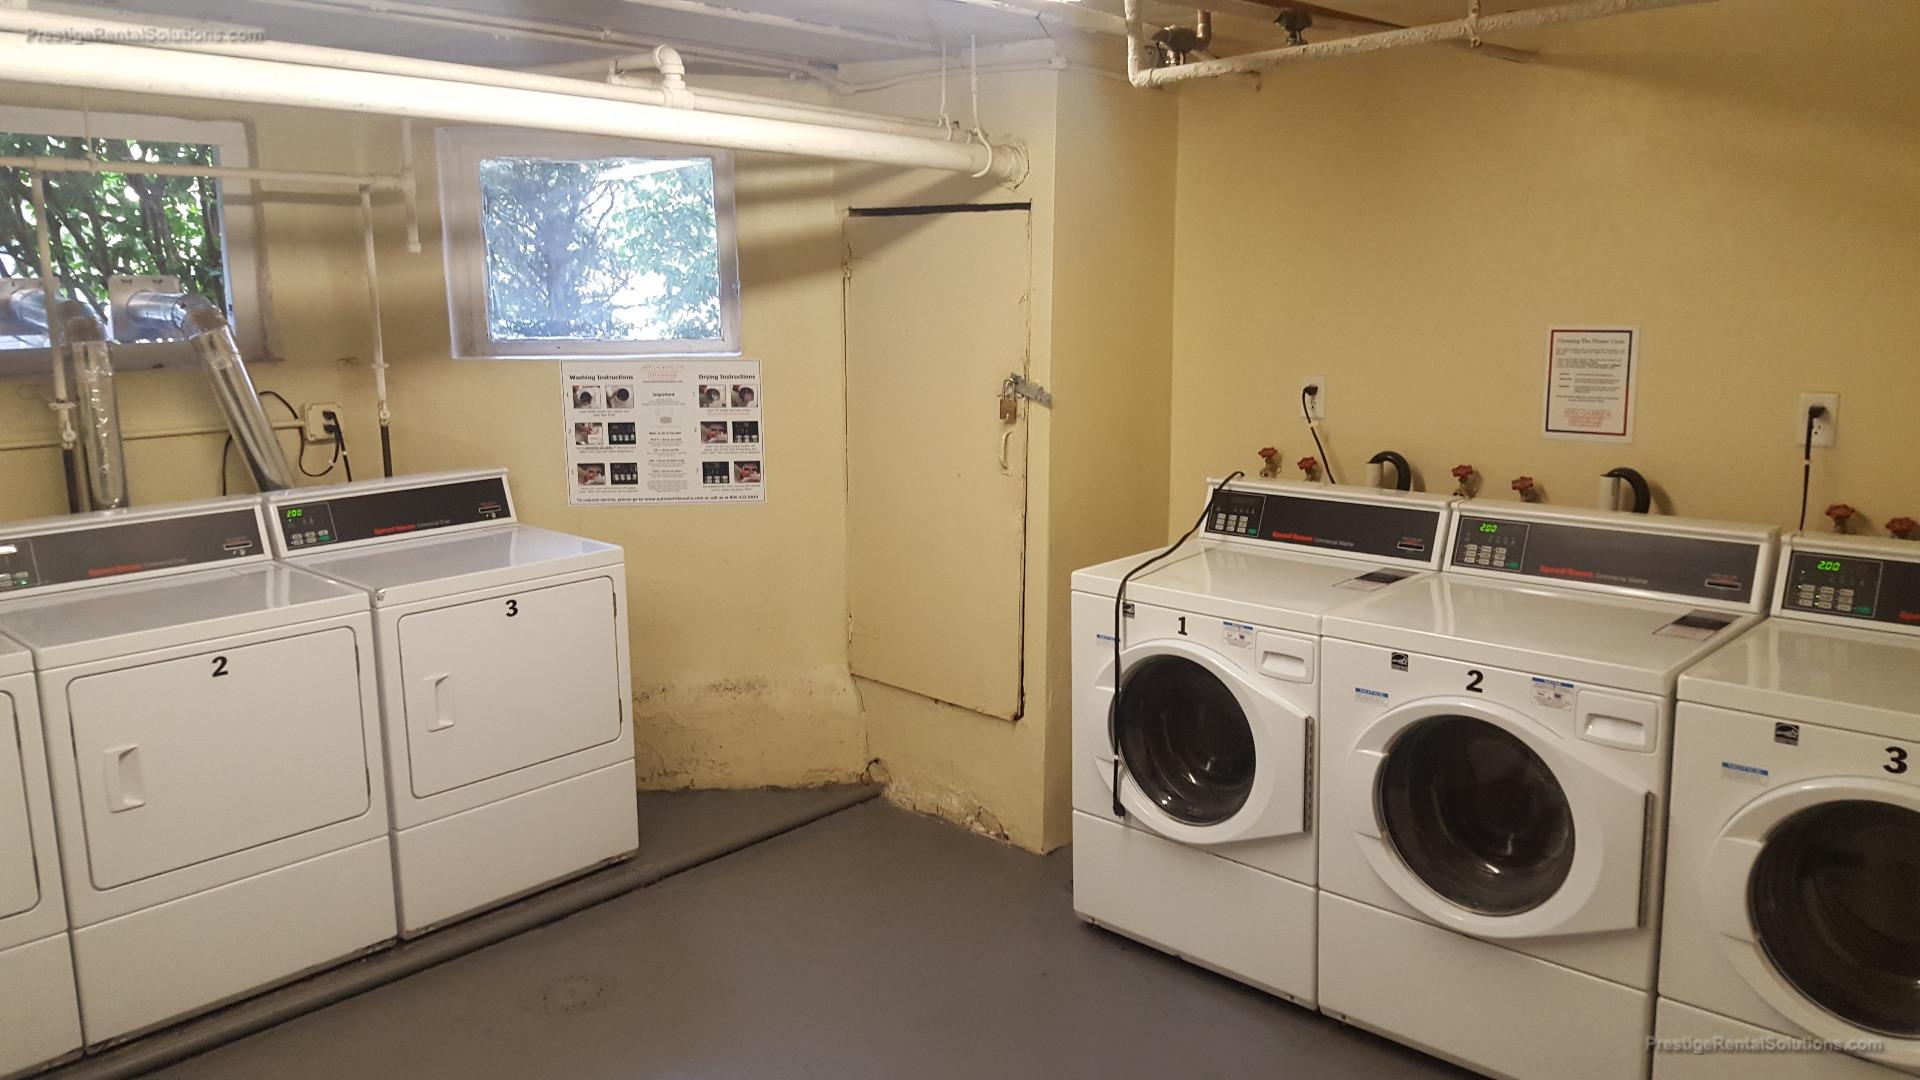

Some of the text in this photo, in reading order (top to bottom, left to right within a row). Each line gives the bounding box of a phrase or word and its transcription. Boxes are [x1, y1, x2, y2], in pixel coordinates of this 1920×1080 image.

[698, 373, 719, 381] Drying
[505, 600, 519, 617] 3
[1177, 616, 1188, 636] 1
[211, 656, 229, 678] 2
[1466, 669, 1484, 694] 2
[1882, 746, 1908, 774] 3
